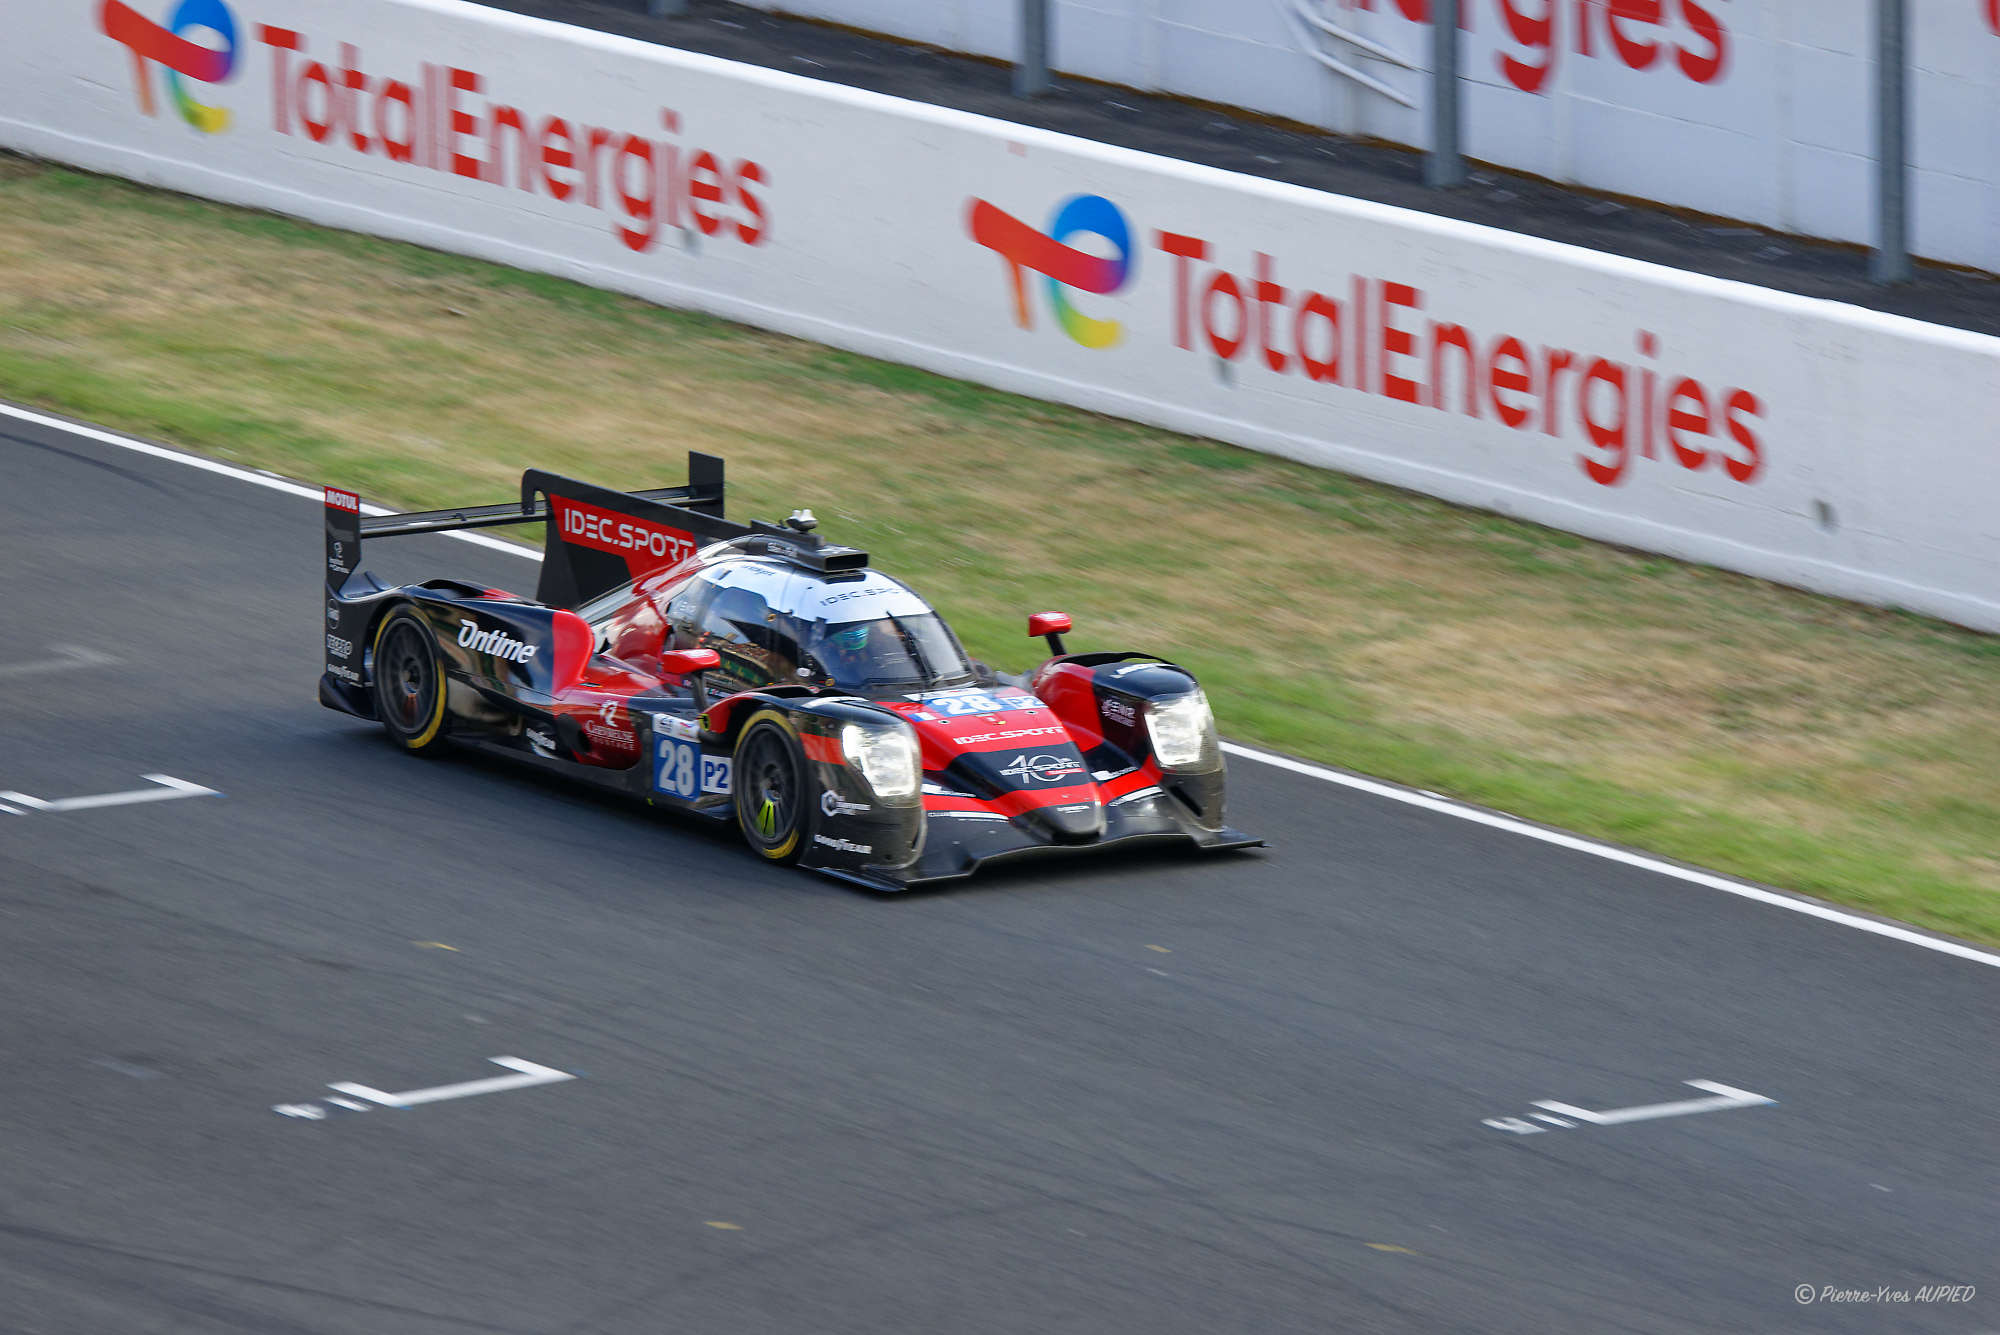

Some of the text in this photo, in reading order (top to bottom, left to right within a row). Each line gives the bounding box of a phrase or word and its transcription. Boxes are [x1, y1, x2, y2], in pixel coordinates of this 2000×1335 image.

[259, 22, 770, 252] TotalEnergies
[1154, 229, 1767, 487] TotalEnergies
[326, 490, 358, 510] MOTUL
[457, 618, 539, 664] Ontime
[932, 695, 1003, 715] 28
[659, 739, 729, 796] 28 P2
